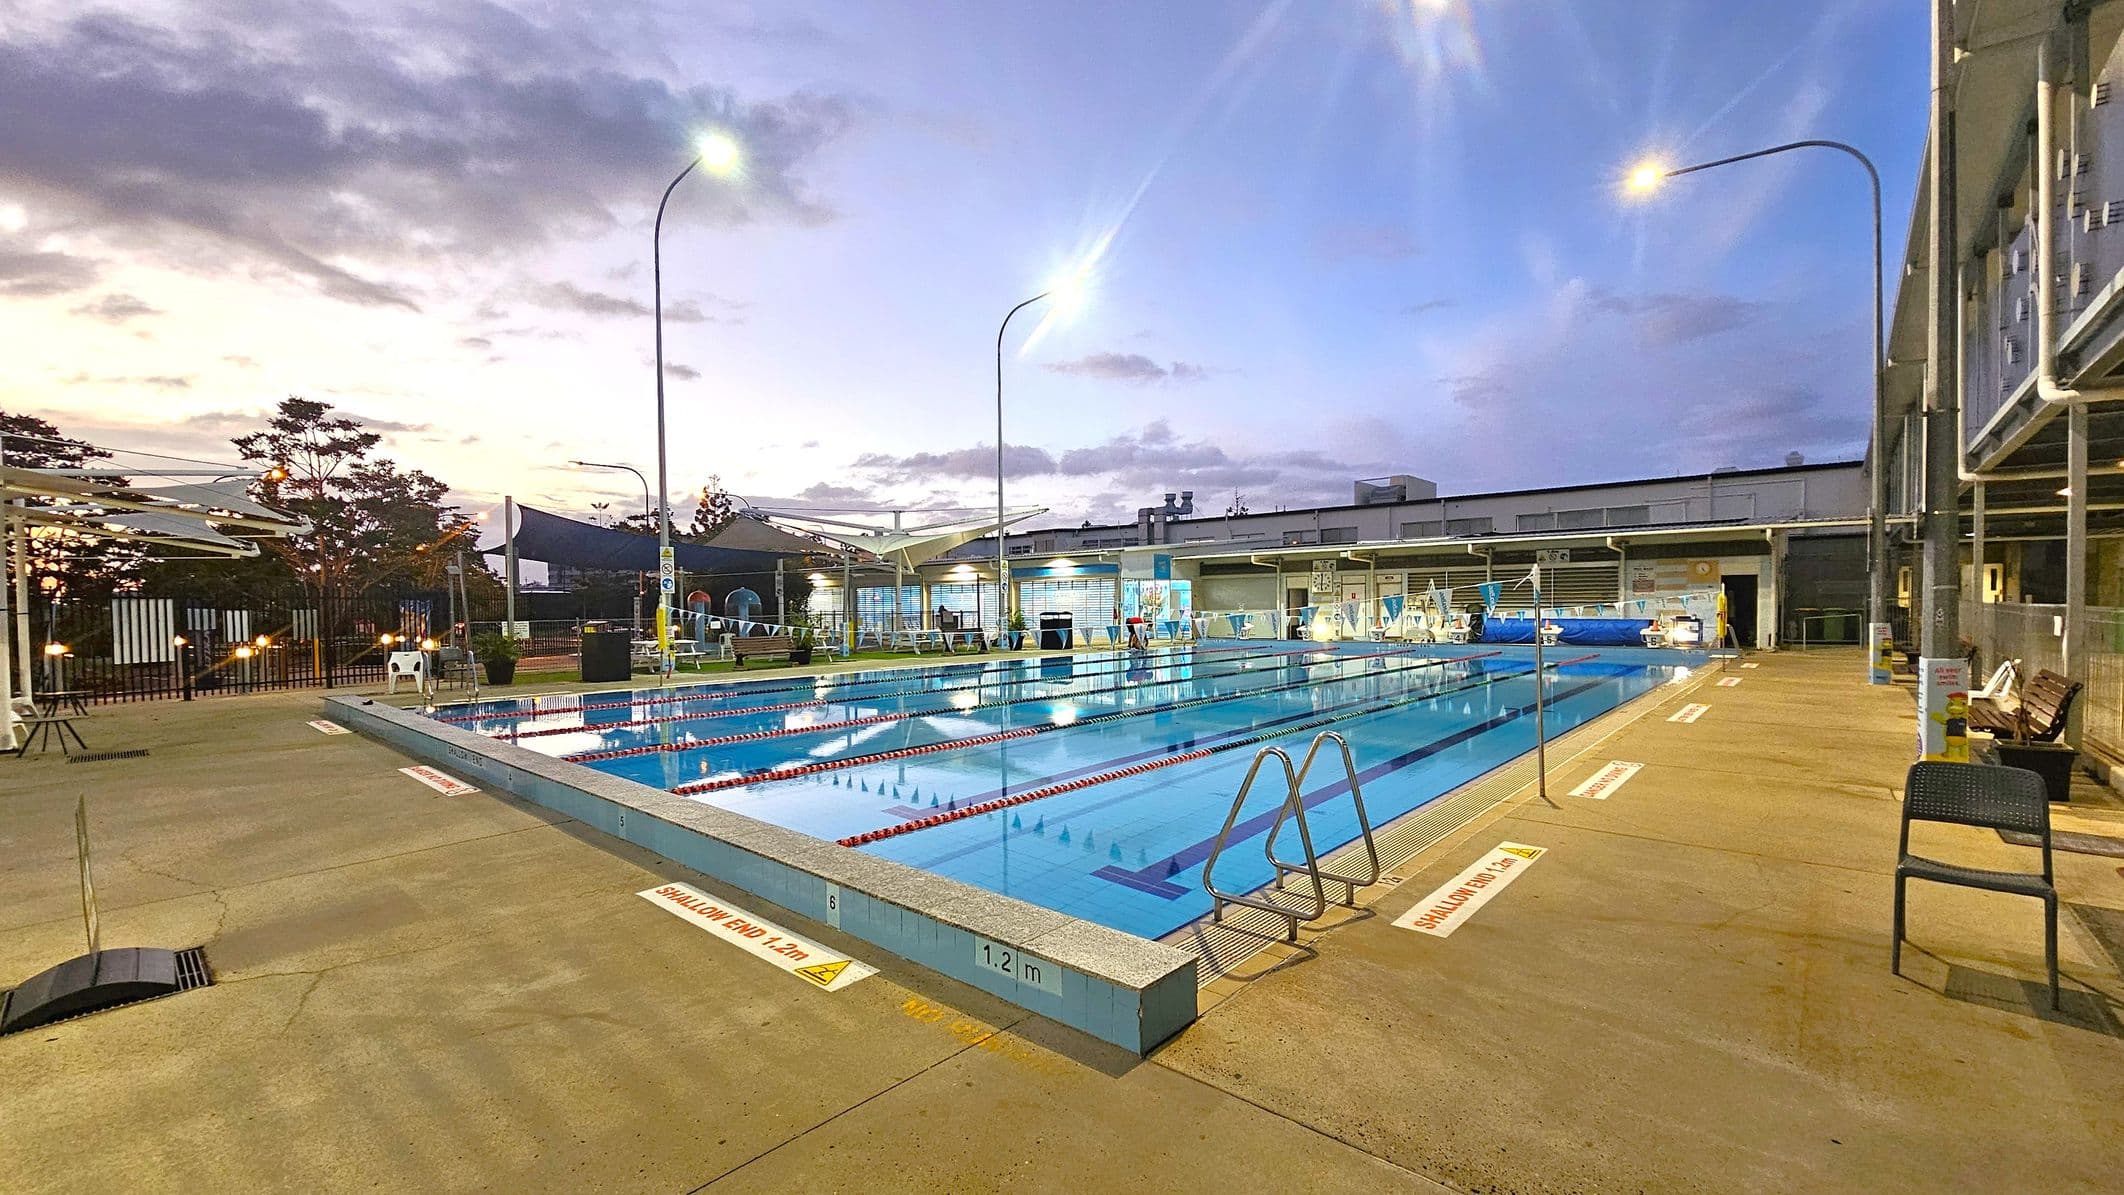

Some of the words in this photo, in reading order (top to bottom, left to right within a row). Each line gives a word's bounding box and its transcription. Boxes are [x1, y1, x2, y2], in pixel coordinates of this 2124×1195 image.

[1650, 637, 1656, 645] 6
[619, 815, 625, 827] 5
[829, 895, 836, 910] 6
[1413, 887, 1478, 930] SHALLOW
[1465, 872, 1498, 890] END
[1491, 857, 1519, 873] 1.2m
[655, 886, 732, 921] SHALLOW
[722, 918, 767, 939] END
[762, 936, 810, 962] 1.2m
[983, 944, 1011, 973] 1.2
[1025, 963, 1041, 984] m
